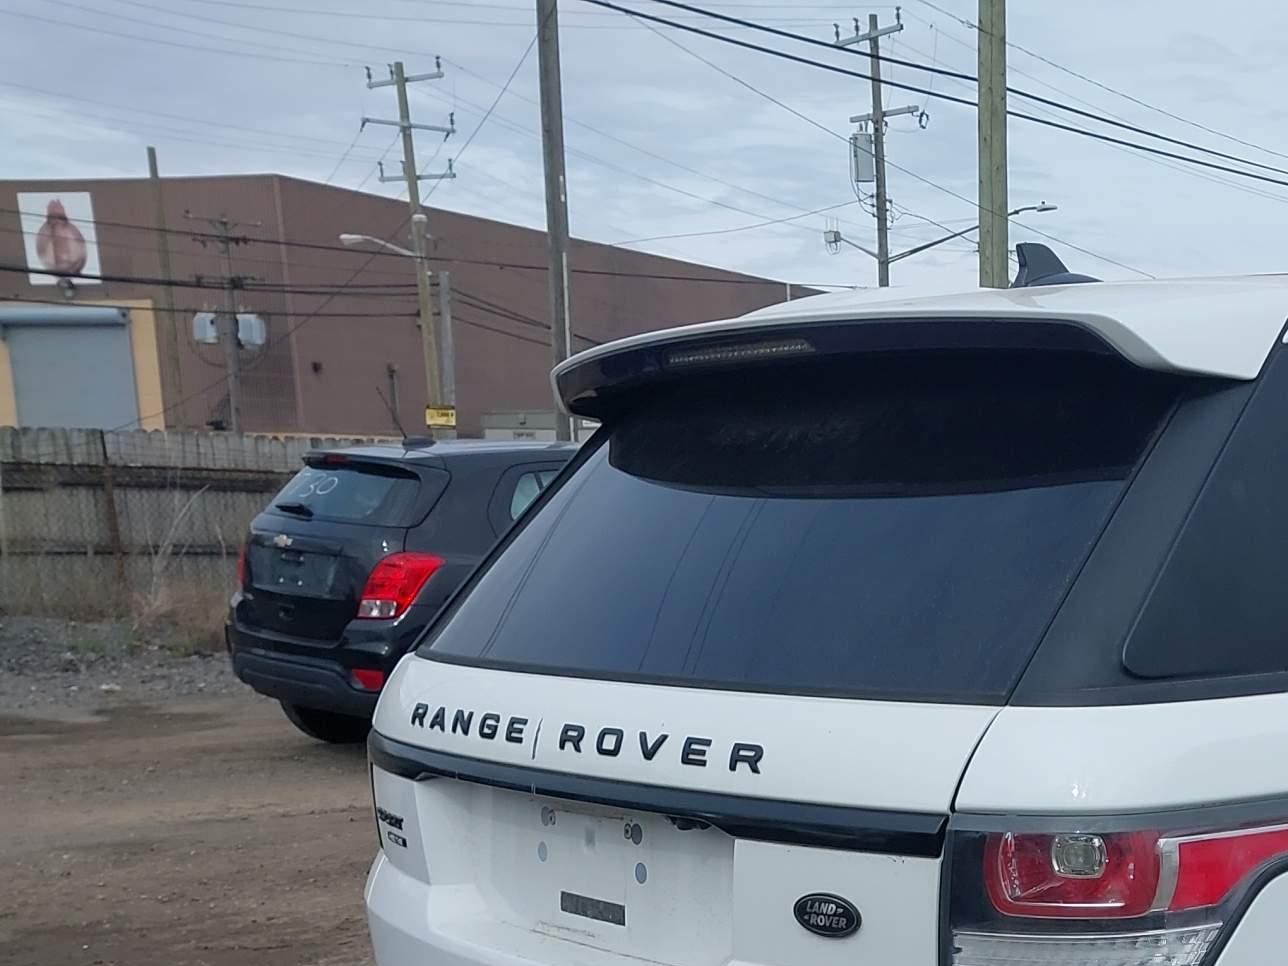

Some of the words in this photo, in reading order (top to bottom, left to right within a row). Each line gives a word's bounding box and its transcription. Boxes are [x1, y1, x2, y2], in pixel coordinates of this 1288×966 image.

[410, 702, 529, 744] RANGE
[558, 723, 764, 775] ROVER
[806, 900, 837, 915] LAND
[809, 913, 848, 929] ROVER
